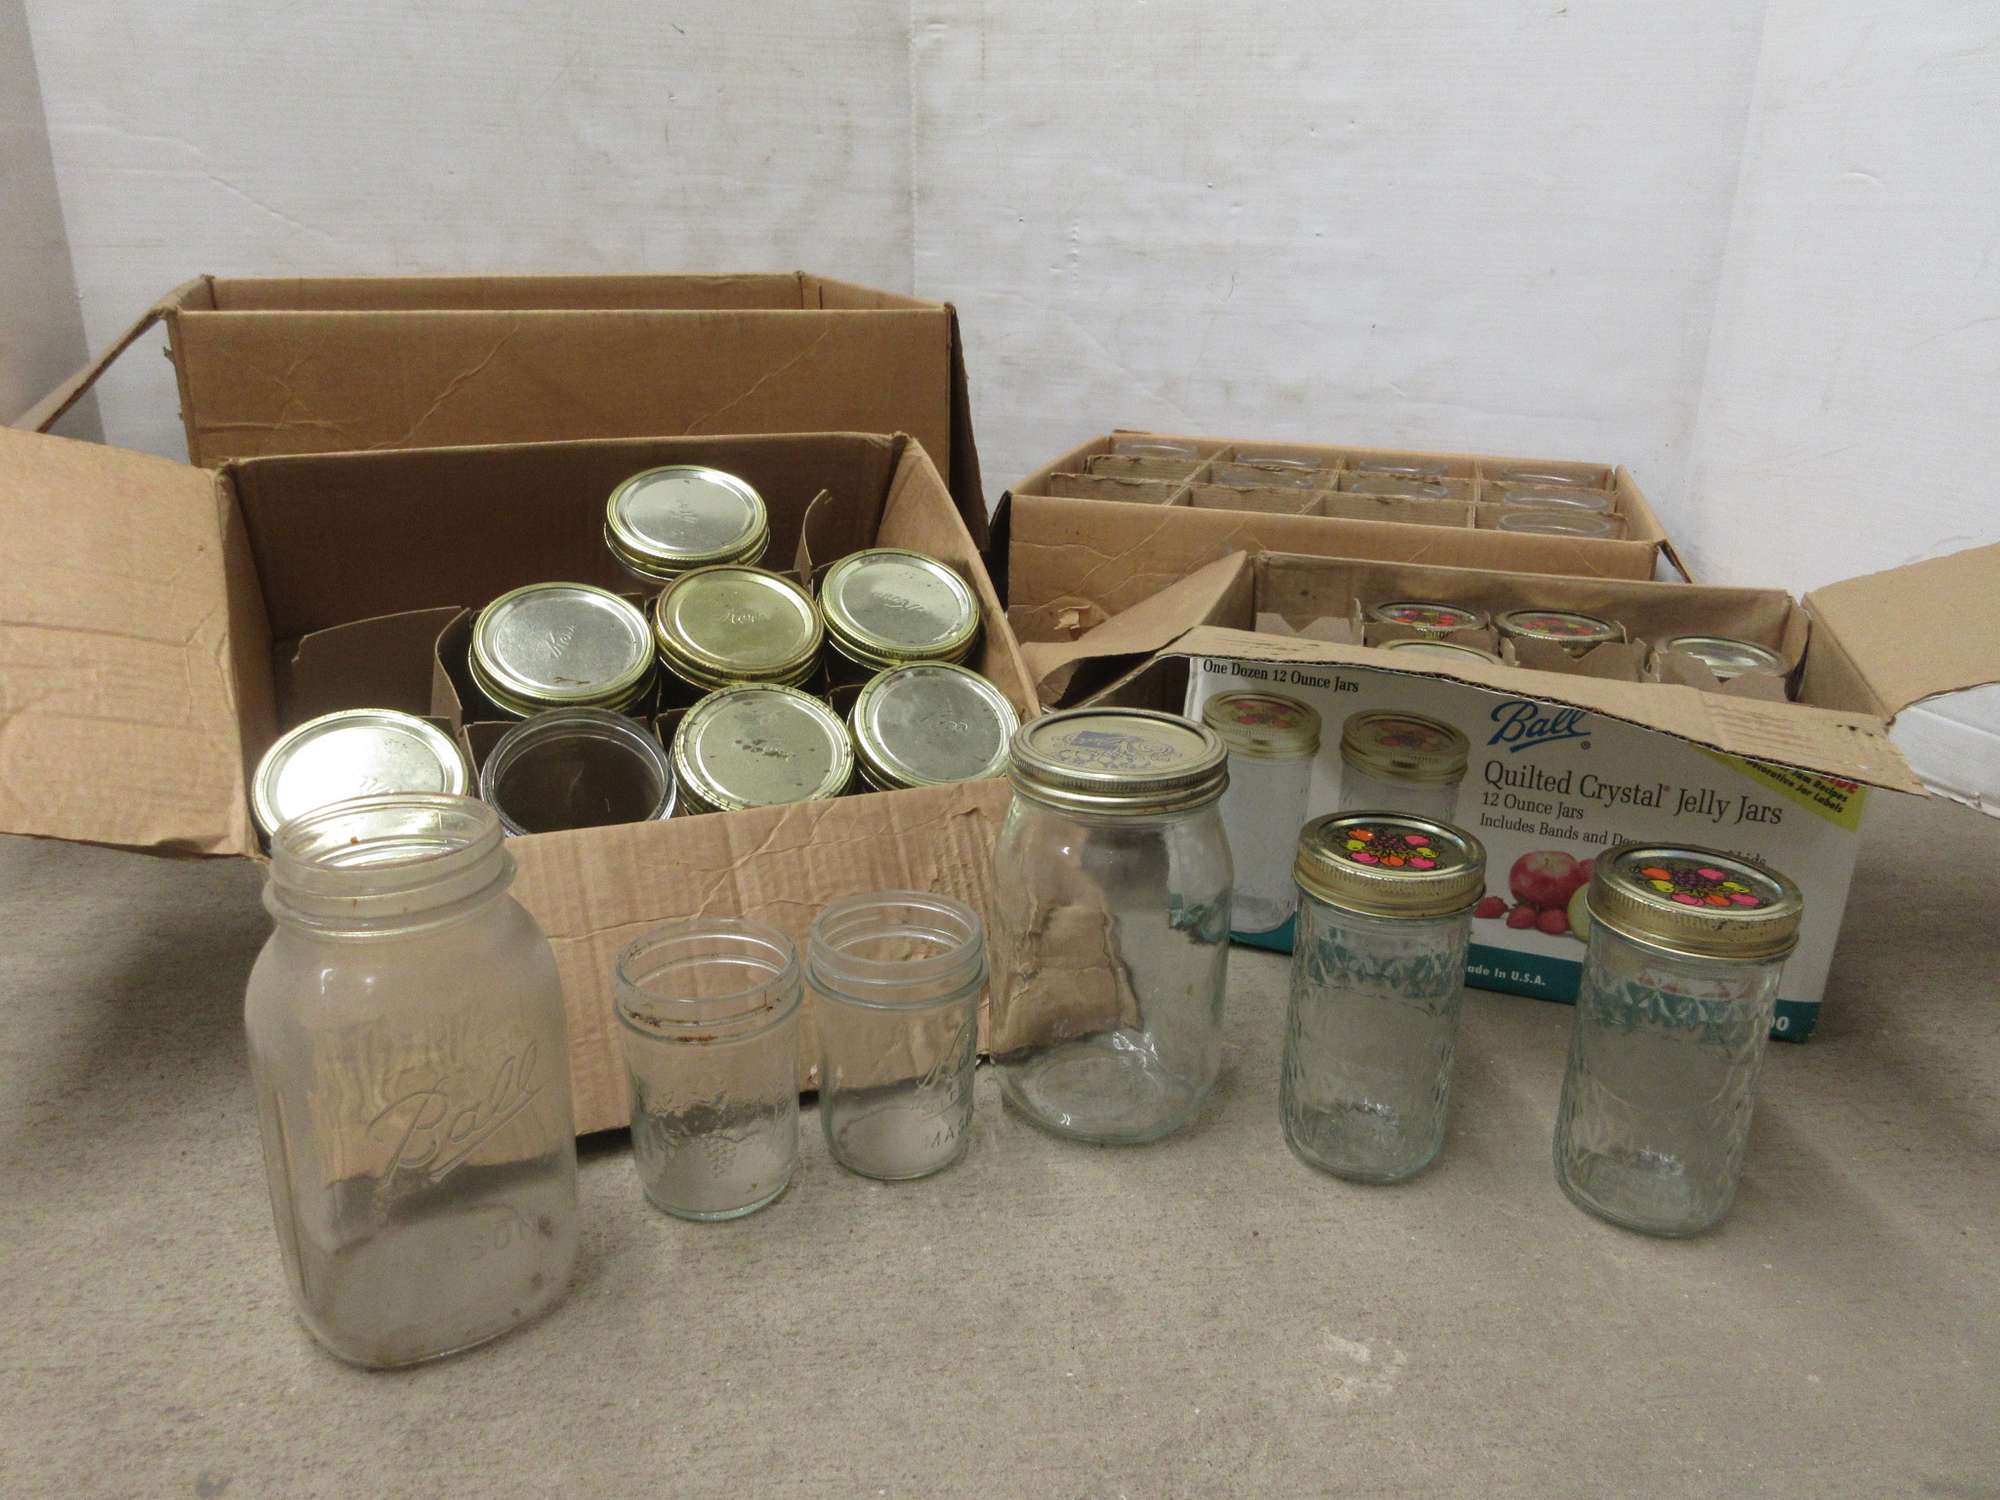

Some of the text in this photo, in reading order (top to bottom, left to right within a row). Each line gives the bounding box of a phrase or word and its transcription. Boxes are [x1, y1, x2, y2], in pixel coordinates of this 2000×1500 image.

[1203, 658, 1360, 693] One Dozen 12 Ounce Jars
[1487, 700, 1592, 753] Ball
[1481, 791, 1585, 820] 12 Ounce Jars
[1484, 760, 1572, 795] Quilted
[1673, 788, 1731, 823] Jelly
[1734, 795, 1783, 824] Jars
[1480, 812, 1535, 833] Includes
[1538, 822, 1580, 841] Bands
[1582, 831, 1608, 846] and
[1466, 964, 1490, 977] ade
[1511, 970, 1547, 987] U.S.A.
[366, 1040, 547, 1192] Ball
